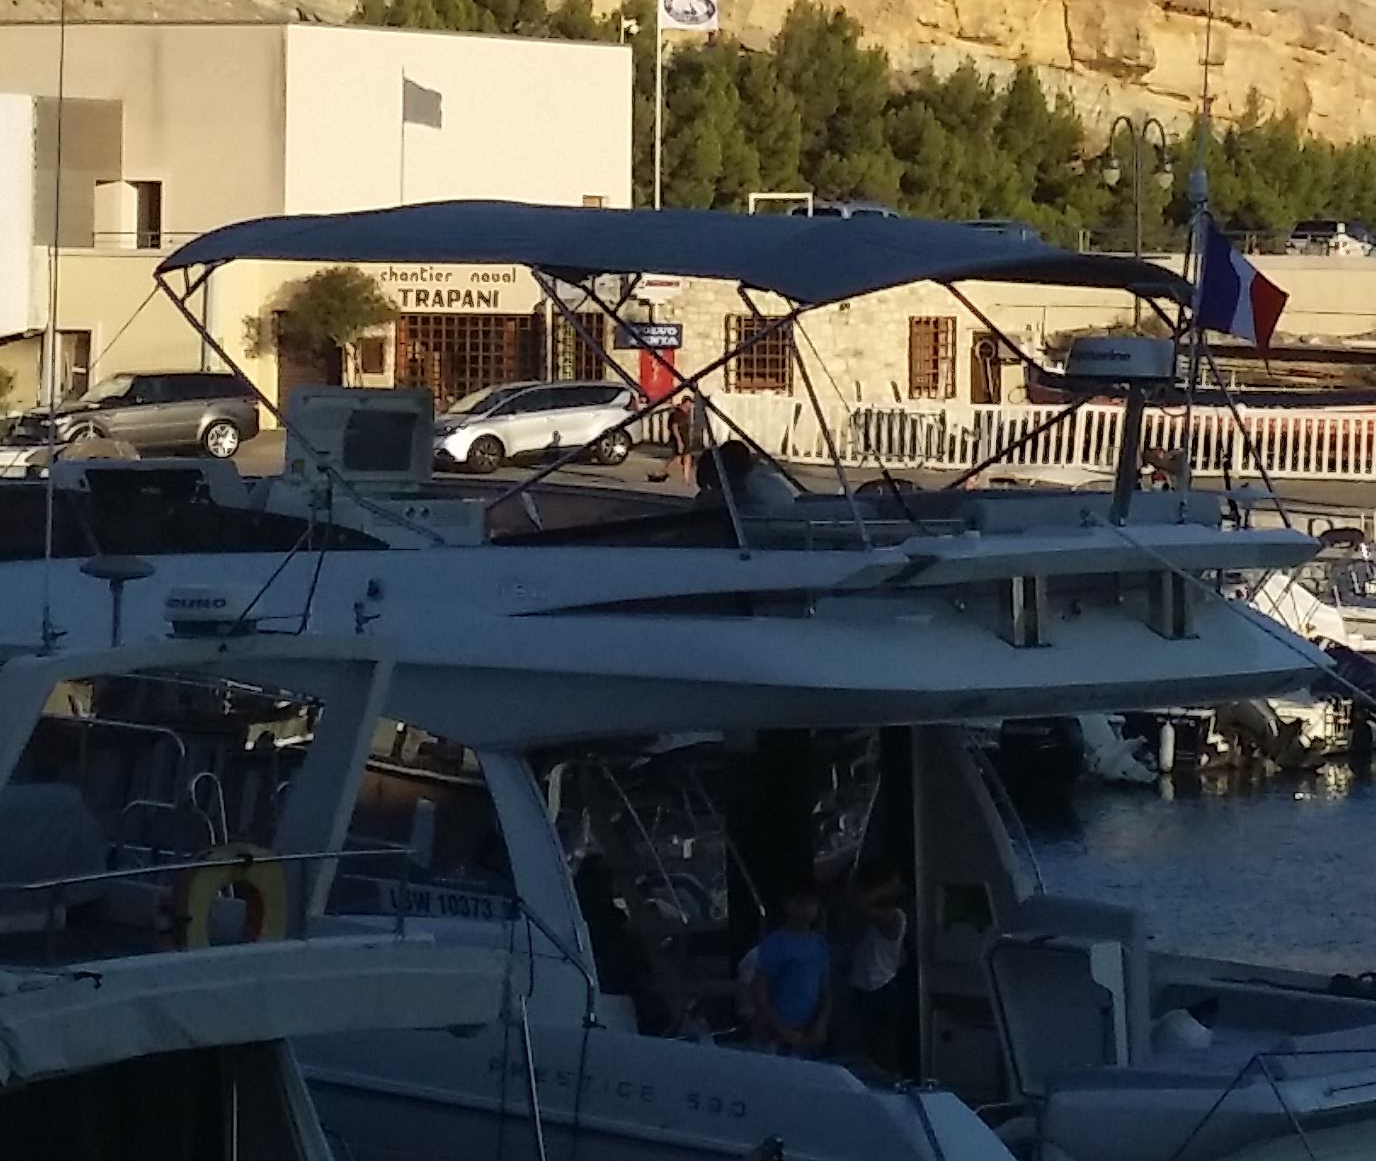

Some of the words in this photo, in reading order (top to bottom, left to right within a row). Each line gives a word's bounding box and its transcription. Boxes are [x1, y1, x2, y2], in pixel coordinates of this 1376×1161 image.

[380, 267, 453, 284] chantier
[397, 288, 500, 309] TRAPANI
[438, 894, 492, 919] 10373
